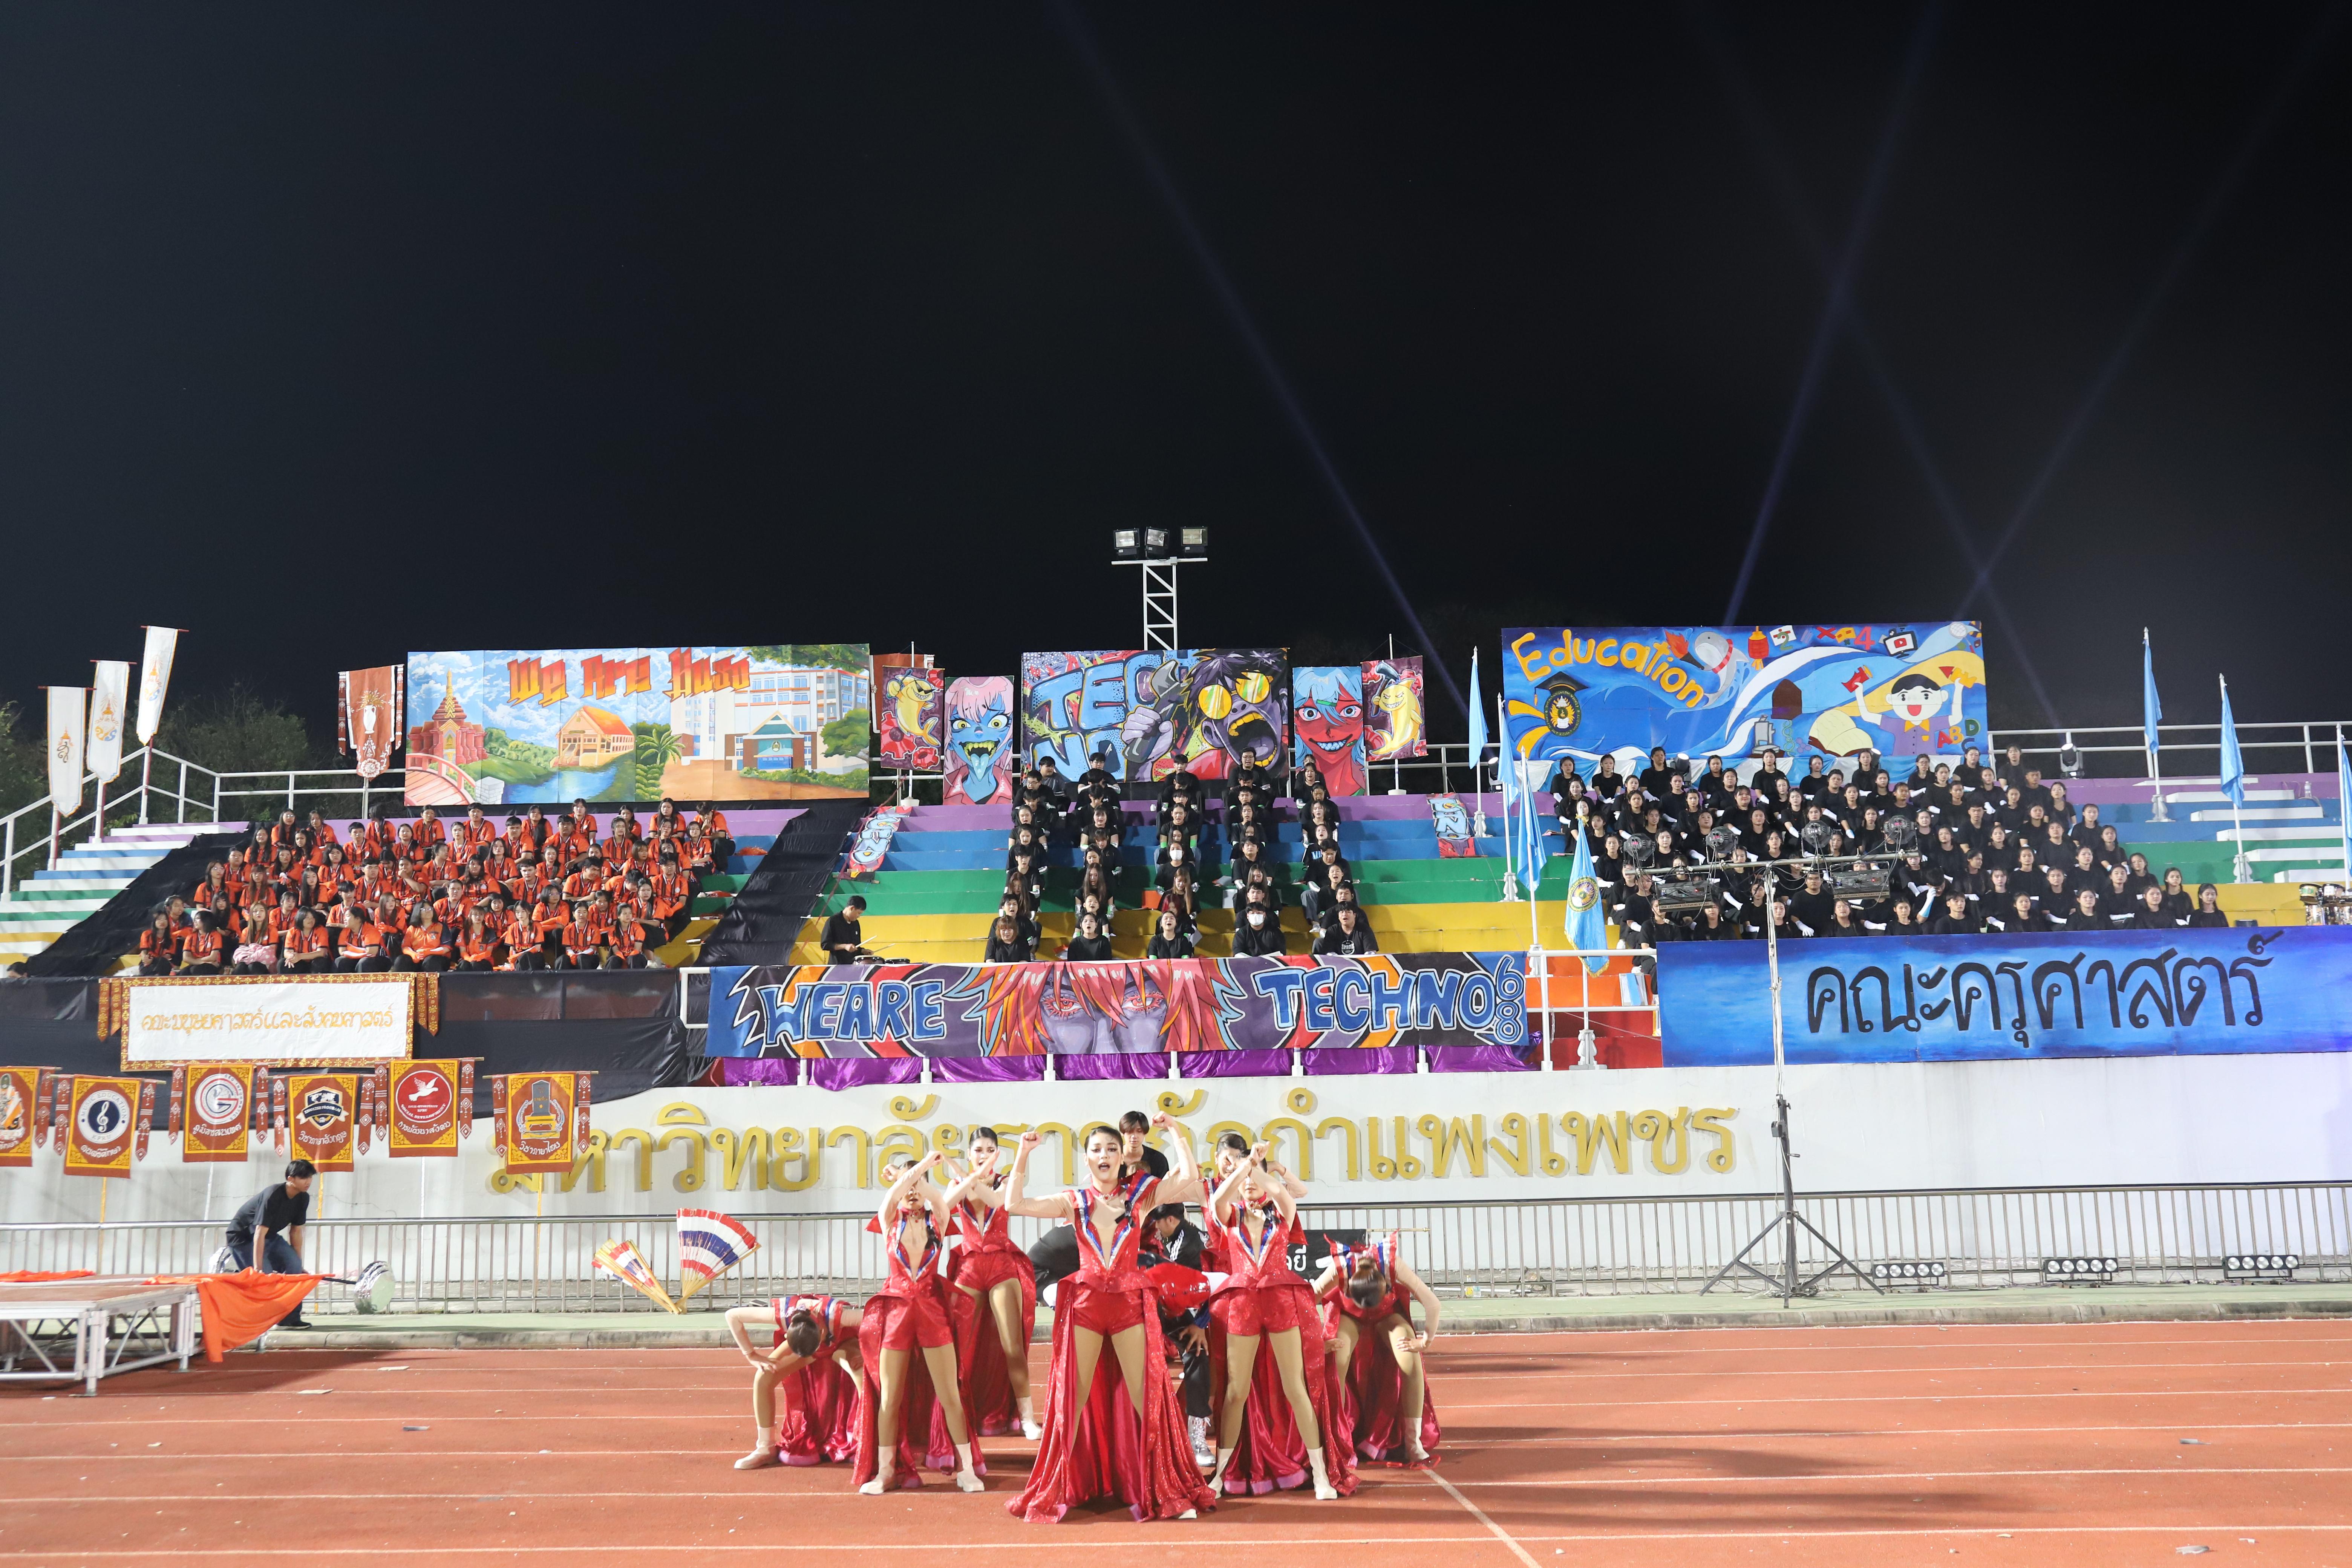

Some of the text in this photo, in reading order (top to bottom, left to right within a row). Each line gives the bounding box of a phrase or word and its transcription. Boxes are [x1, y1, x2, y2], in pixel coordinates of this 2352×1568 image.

[1511, 629, 1705, 708] Education
[1252, 967, 1496, 1032] TECHNO
[1807, 930, 2284, 1048] คณะครุศาสตร์
[141, 1003, 394, 1036] คณะมนุษยศาสตร์และสังคมศาสตร์
[81, 1092, 127, 1119] MUSIC EDUCATION
[401, 1103, 446, 1119] SOCIAL DEVELOPMENT
